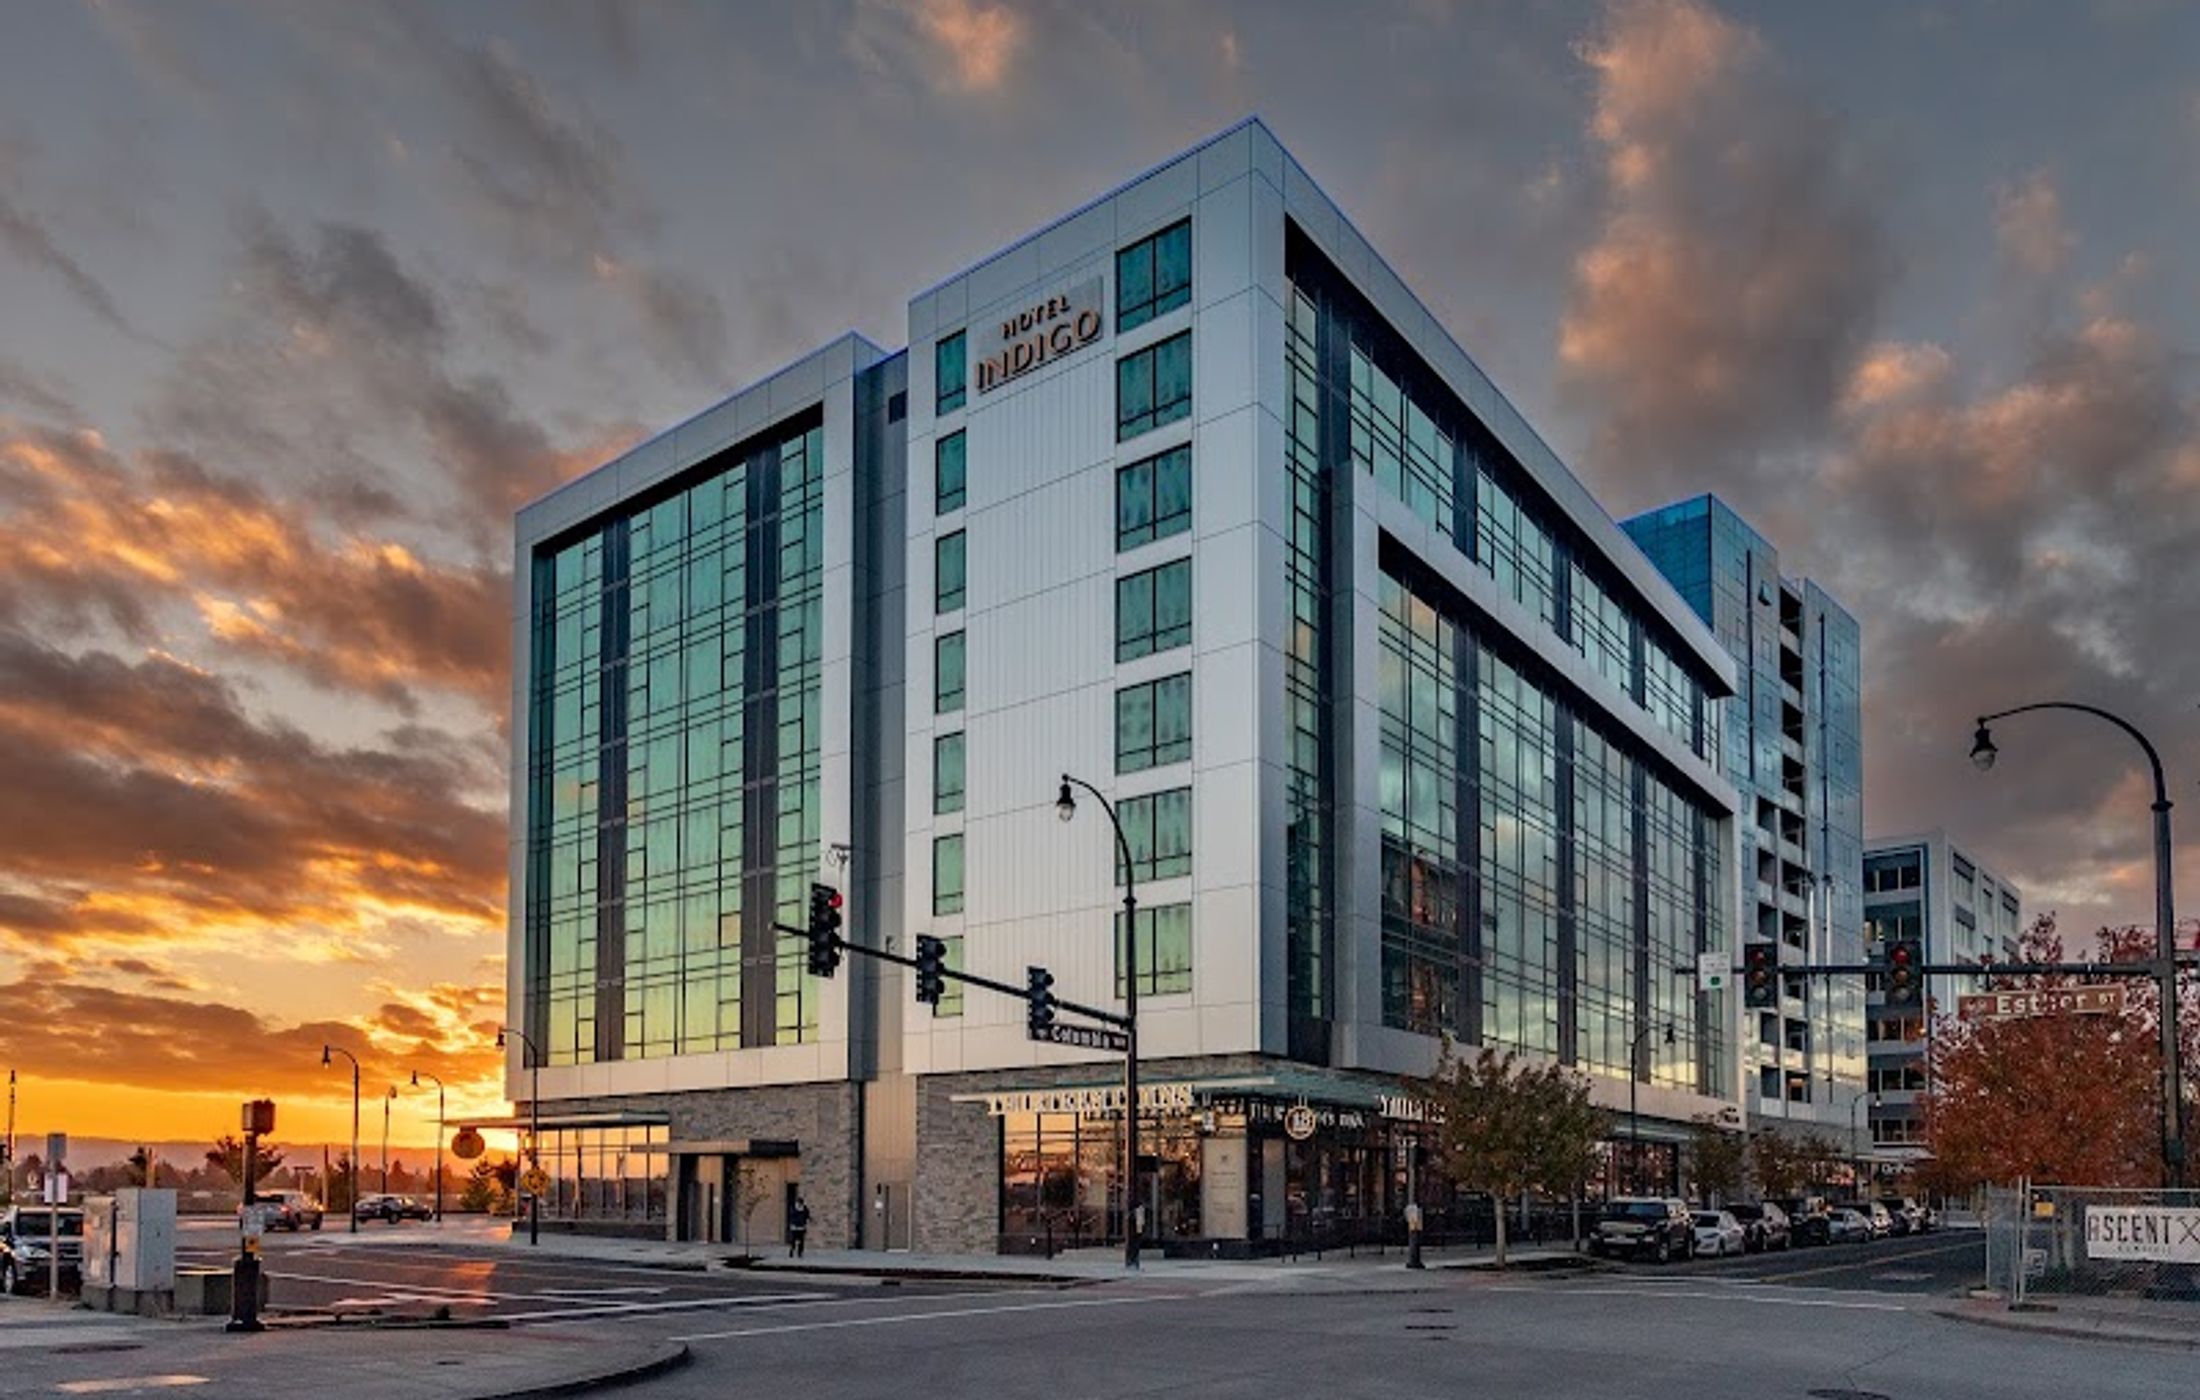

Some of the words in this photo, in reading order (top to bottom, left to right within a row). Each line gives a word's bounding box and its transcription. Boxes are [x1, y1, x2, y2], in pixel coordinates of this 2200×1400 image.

[1002, 295, 1071, 339] HOTEL
[974, 309, 1101, 390] INDIGO
[2087, 1213, 2171, 1245] ASCENT
